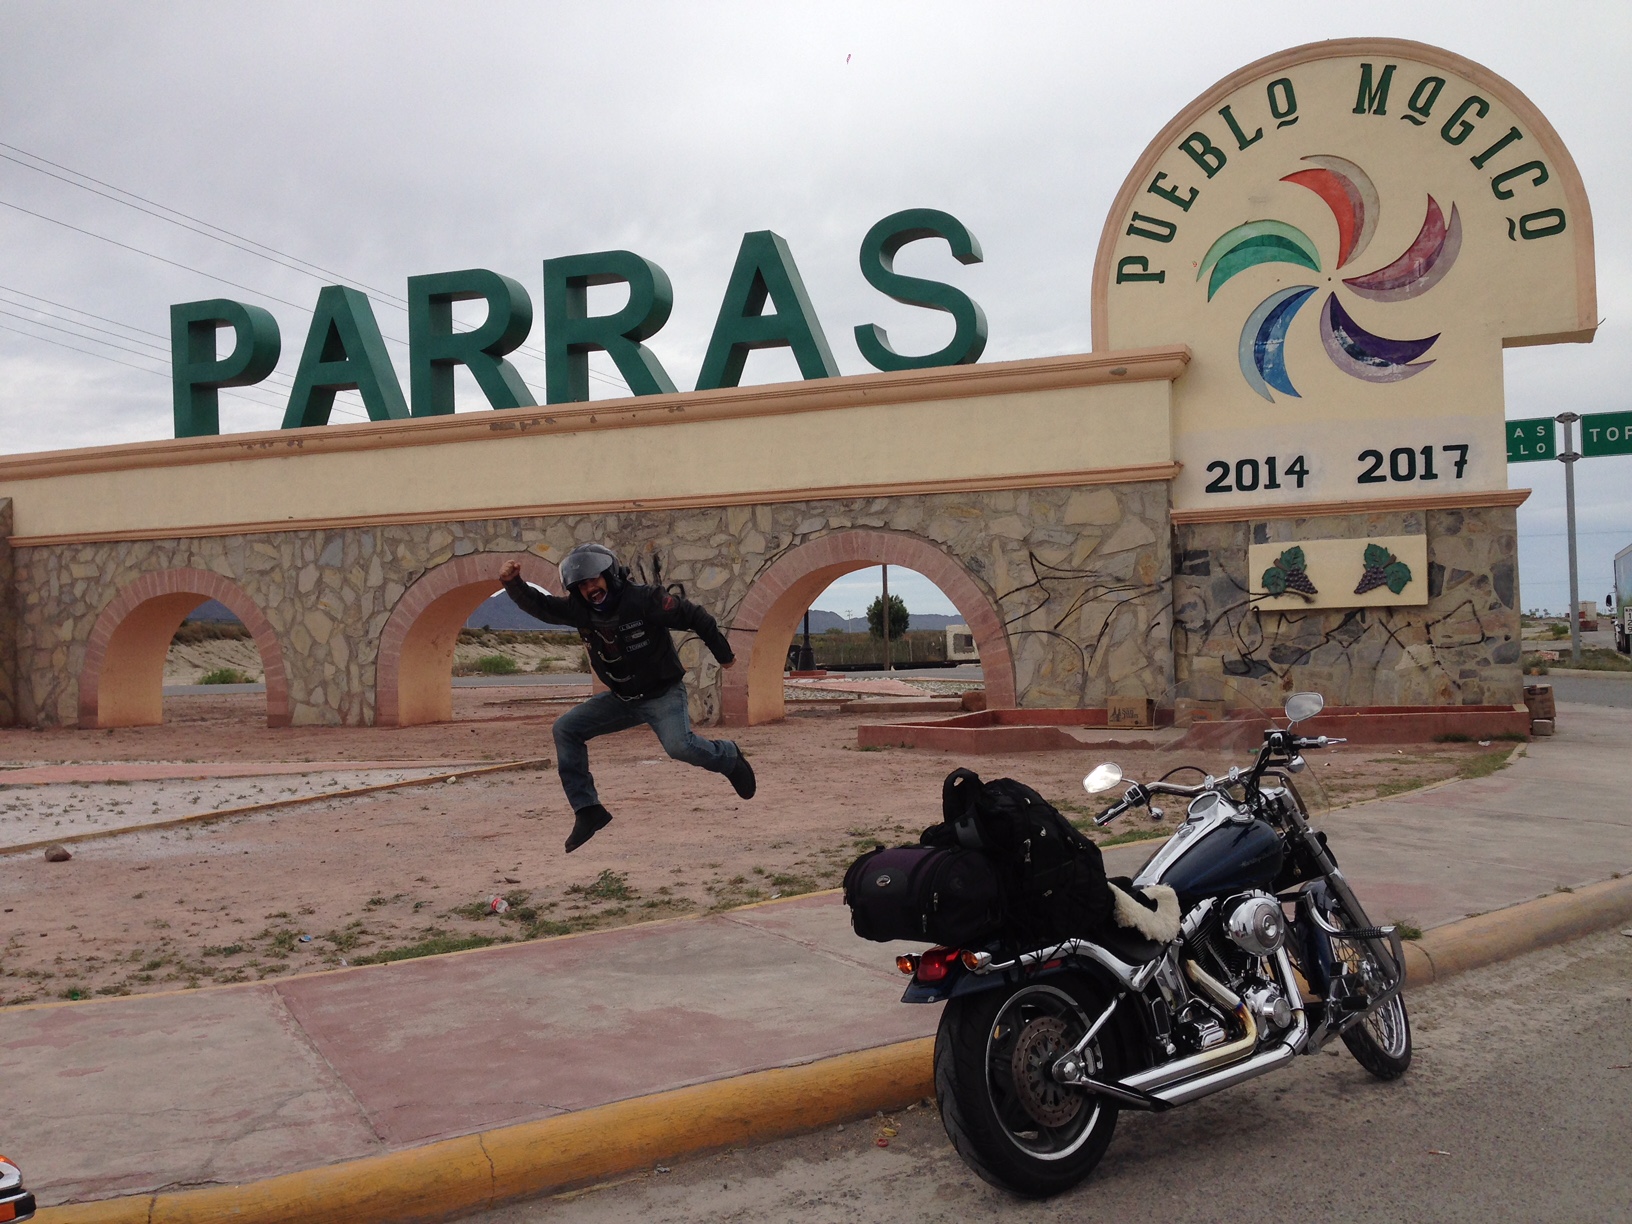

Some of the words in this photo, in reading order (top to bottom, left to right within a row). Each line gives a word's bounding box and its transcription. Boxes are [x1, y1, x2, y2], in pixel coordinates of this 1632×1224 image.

[1116, 77, 1299, 285] PUEBLO
[170, 207, 989, 440] PARRAS
[1205, 454, 1310, 493] 2014
[1357, 443, 1470, 484] 2017
